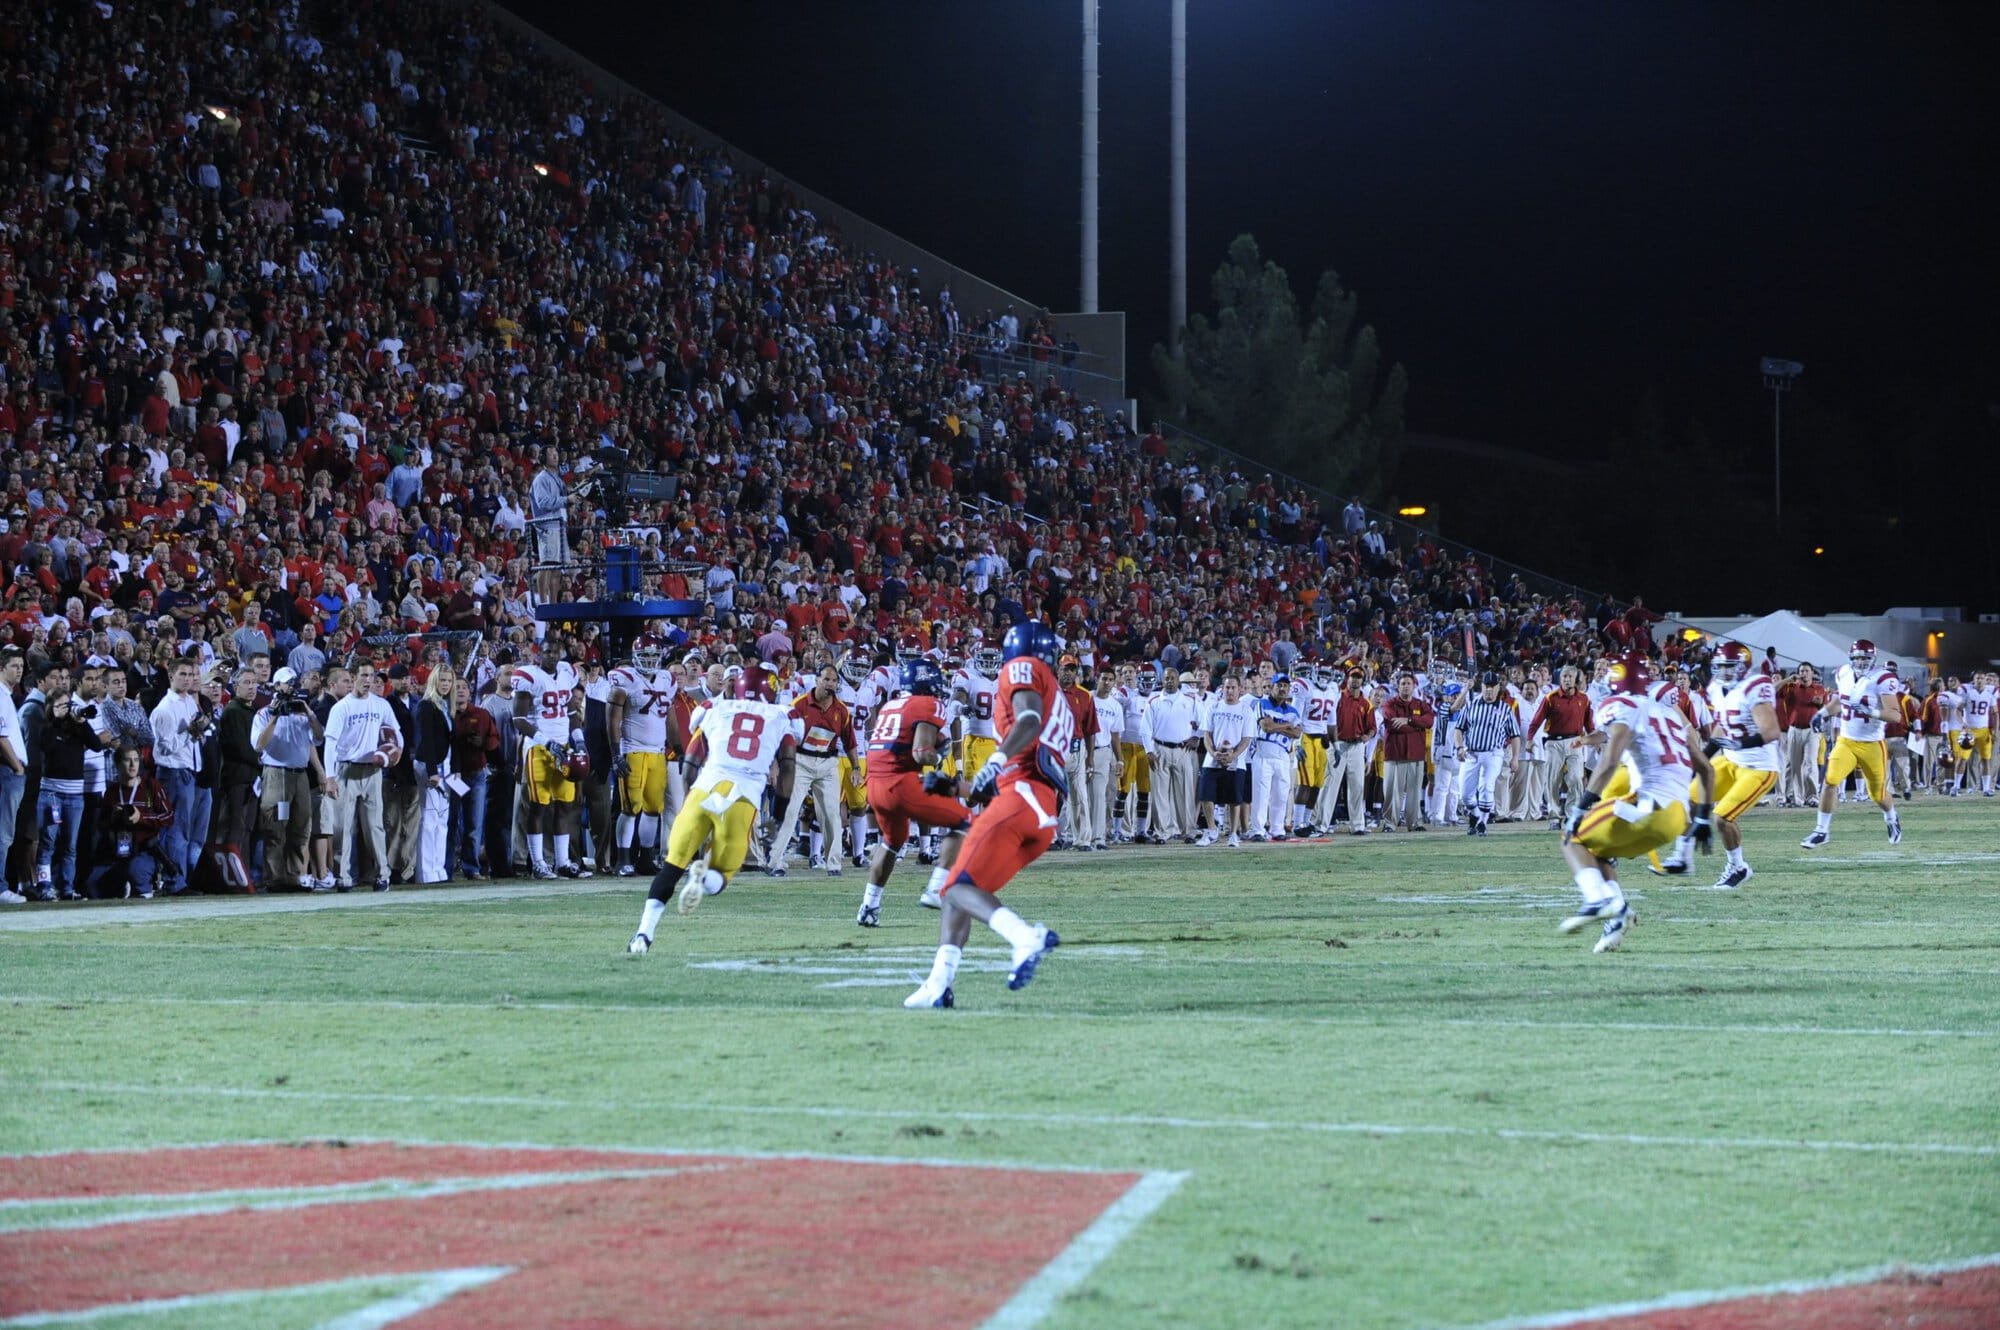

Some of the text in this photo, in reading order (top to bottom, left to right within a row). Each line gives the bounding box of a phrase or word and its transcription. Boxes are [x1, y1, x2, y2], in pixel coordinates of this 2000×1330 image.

[541, 690, 570, 719] 97
[638, 689, 670, 718] 75
[1308, 698, 1334, 721] 26
[1840, 693, 1870, 724] 54
[1970, 700, 1989, 716] 18
[726, 711, 766, 762] 8
[870, 713, 902, 741] 10
[1648, 716, 1693, 769] 15
[214, 852, 249, 887] 20
